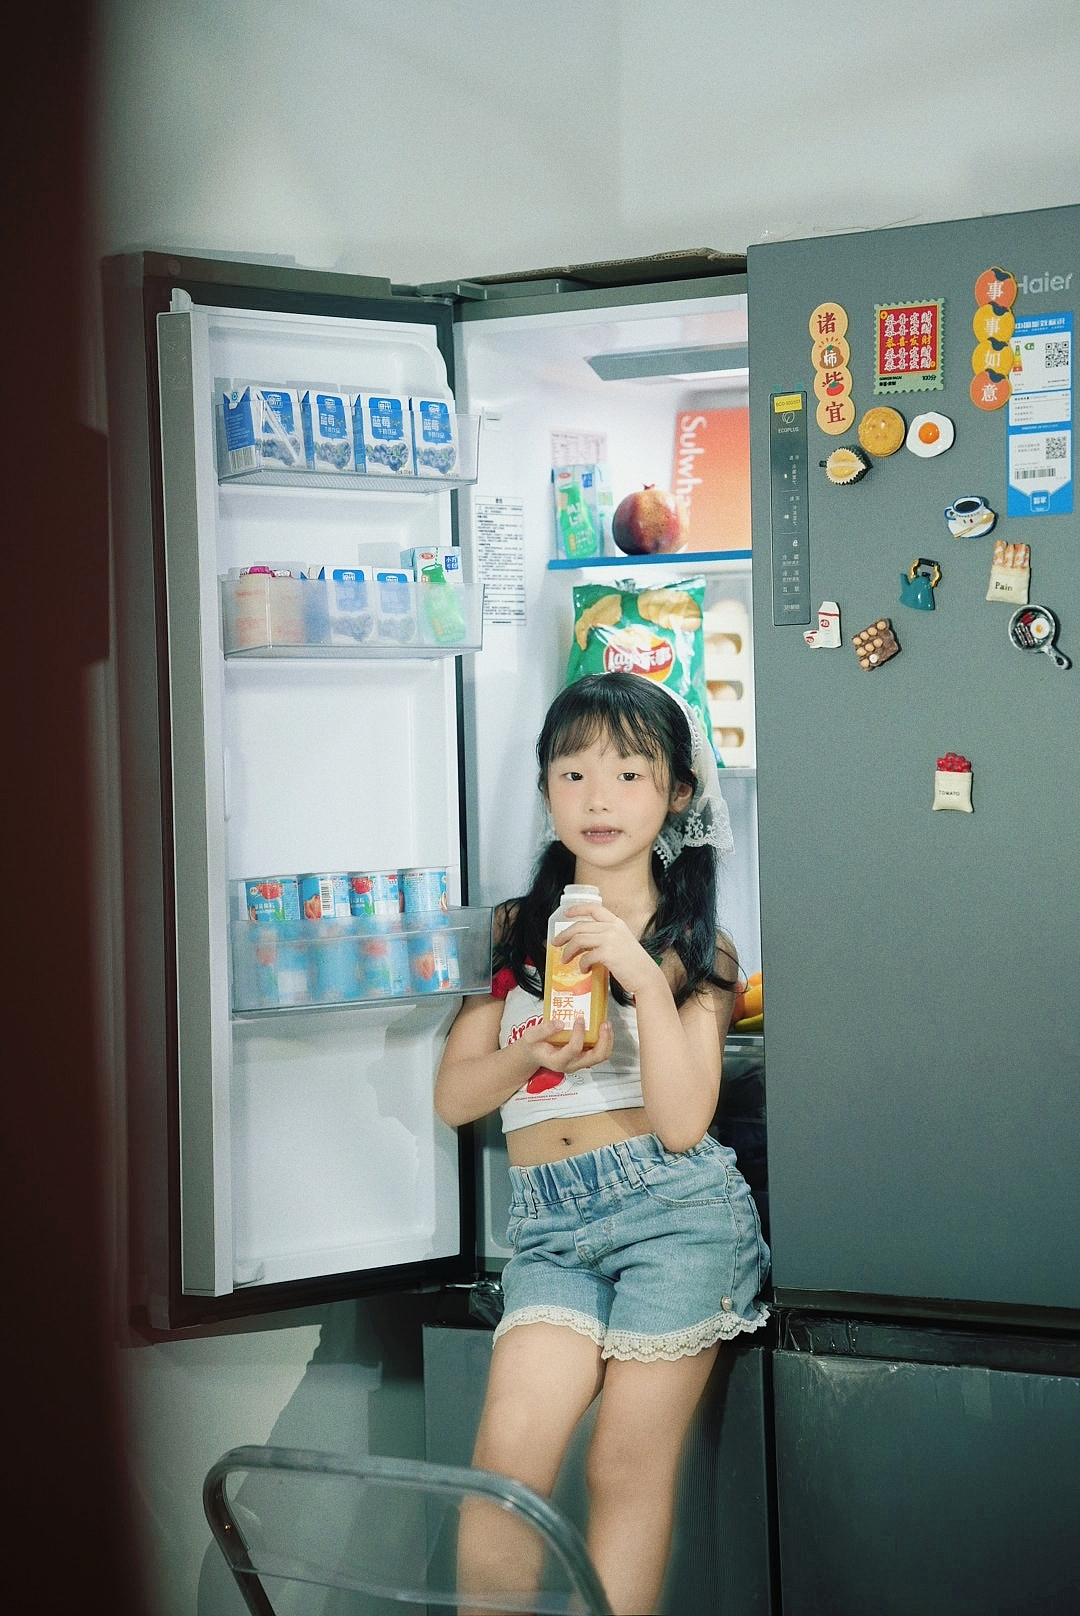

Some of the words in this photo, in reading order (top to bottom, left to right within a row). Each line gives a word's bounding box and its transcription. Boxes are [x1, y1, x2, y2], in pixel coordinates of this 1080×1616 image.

[981, 280, 1004, 404] 事事如意
[995, 581, 1013, 591] Pain
[552, 996, 574, 1008] 每天
